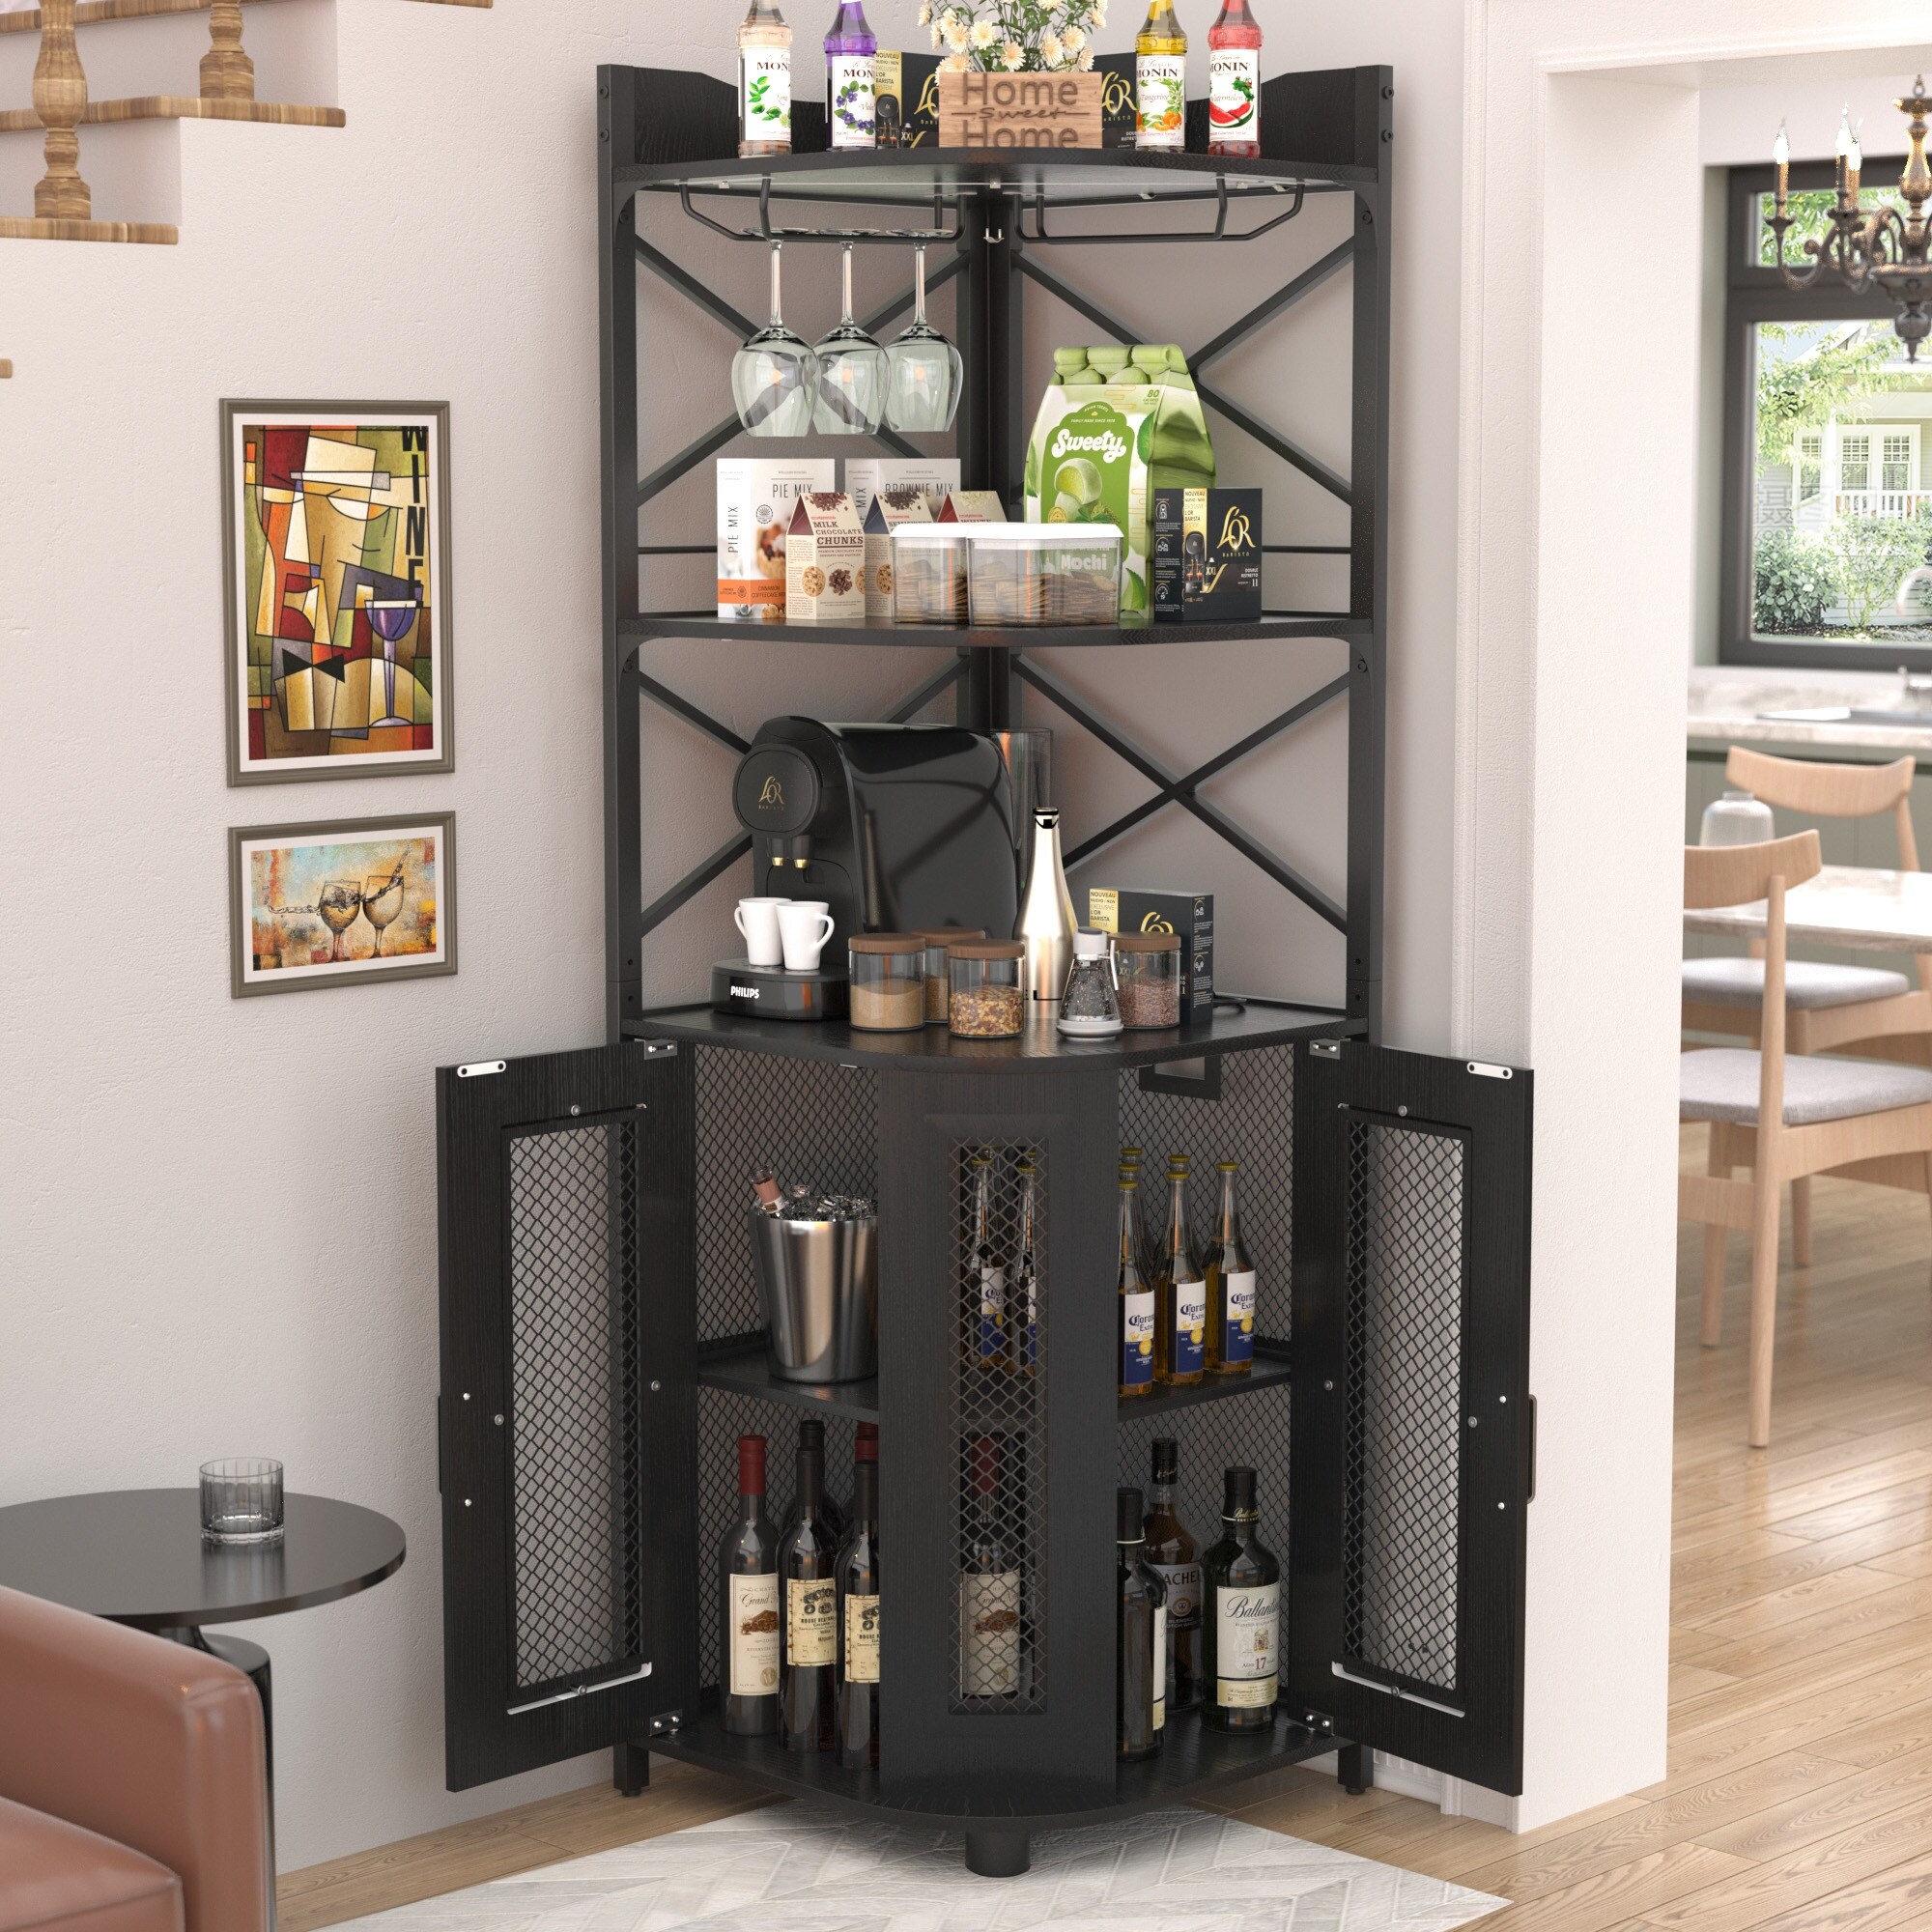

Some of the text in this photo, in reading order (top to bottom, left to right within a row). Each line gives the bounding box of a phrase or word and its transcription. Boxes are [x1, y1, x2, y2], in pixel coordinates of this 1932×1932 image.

[756, 62, 788, 71] MON
[843, 69, 874, 78] MON
[962, 73, 1078, 105] Home
[979, 106, 1065, 120] Sweet
[962, 119, 1079, 148] Home
[1147, 389, 1160, 398] 80
[1051, 428, 1127, 464] Sweety
[772, 484, 813, 498] PIE MIX
[885, 483, 954, 497] BROWNIE MIX
[856, 487, 867, 508] MIX
[727, 506, 739, 554] PIE MIX
[1216, 506, 1257, 552] L'OR
[816, 536, 864, 545] CHUNKS
[1061, 554, 1107, 571] Mochi
[1206, 566, 1217, 576] XXL
[758, 776, 785, 805] L'OR
[730, 985, 760, 1000] PHILIPS
[741, 1593, 769, 1607] Grand
[1255, 1657, 1267, 1670] 17
